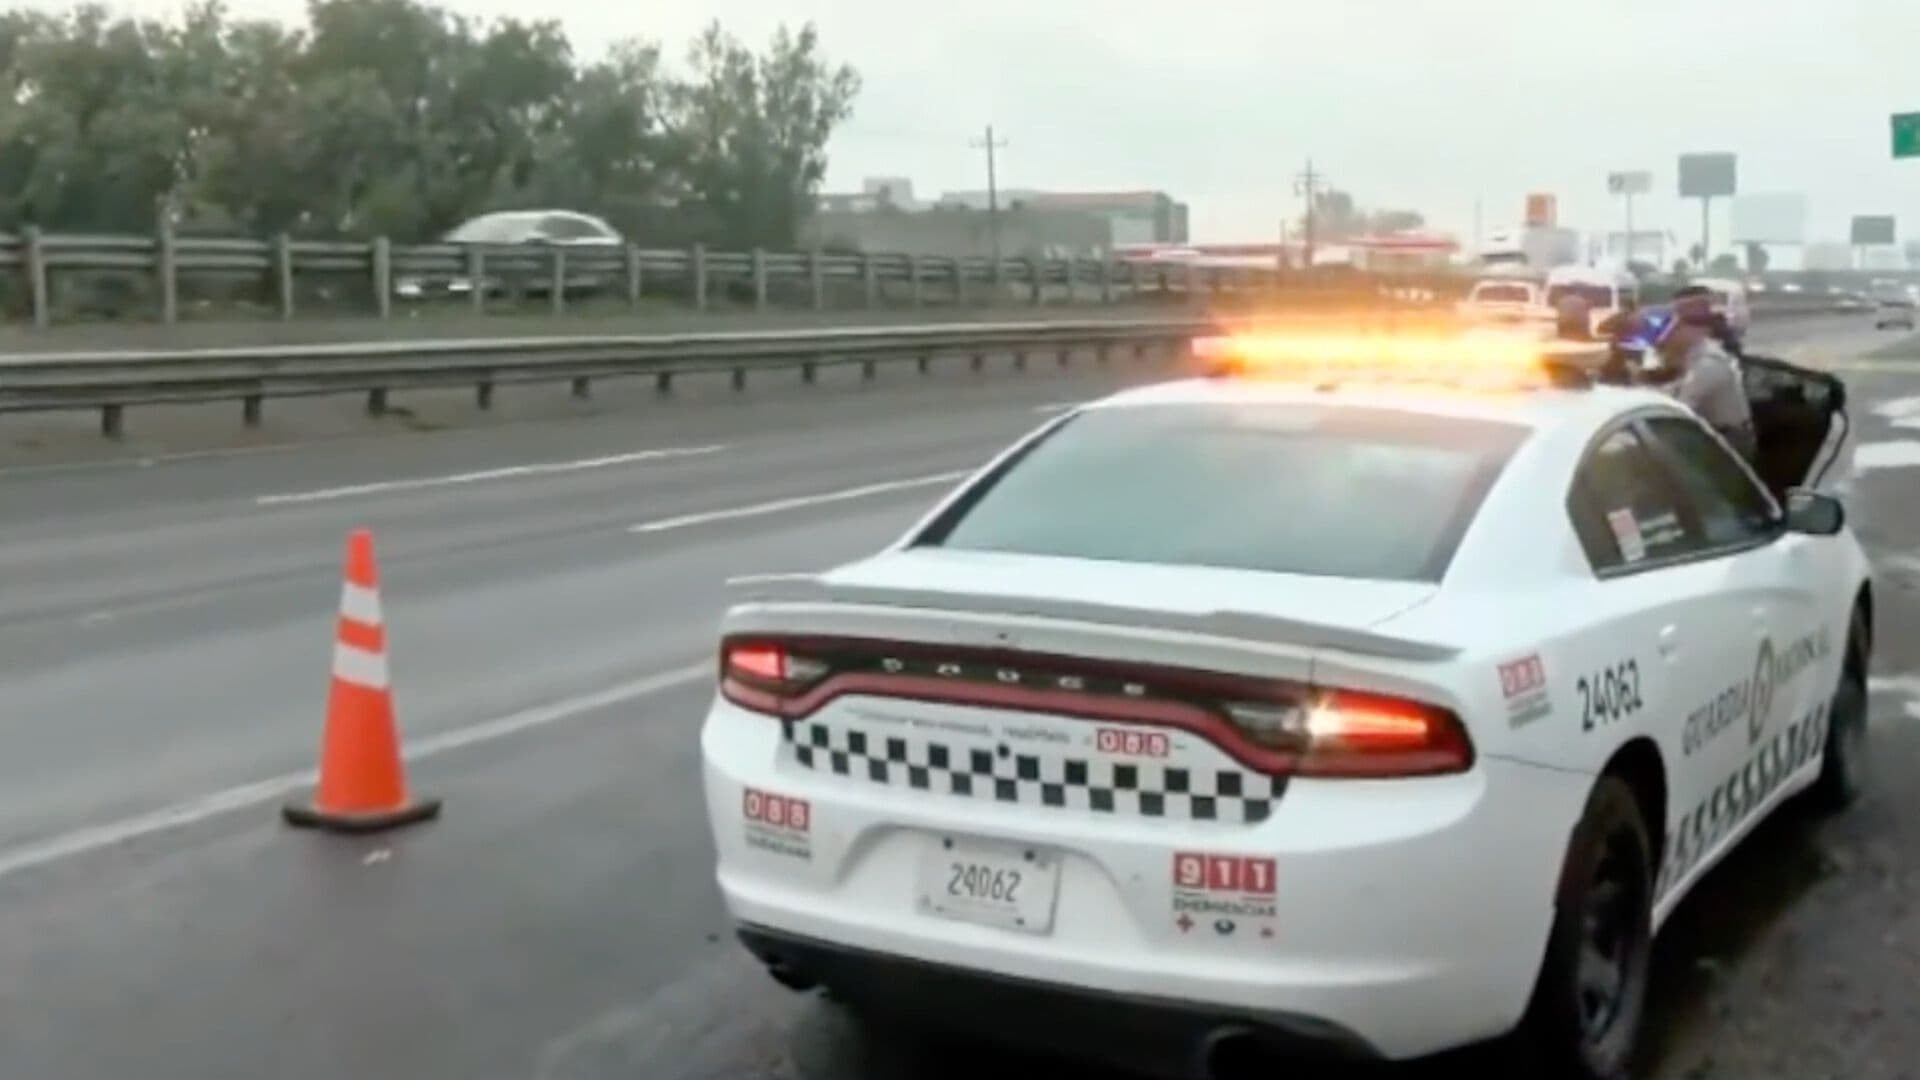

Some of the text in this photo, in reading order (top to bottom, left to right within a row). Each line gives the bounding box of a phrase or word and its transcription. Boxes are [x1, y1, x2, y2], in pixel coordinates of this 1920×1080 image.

[882, 657, 1147, 696] DODGE
[1577, 657, 1643, 733] 24062
[947, 861, 1022, 902] 24062
[1178, 856, 1272, 891] 911
